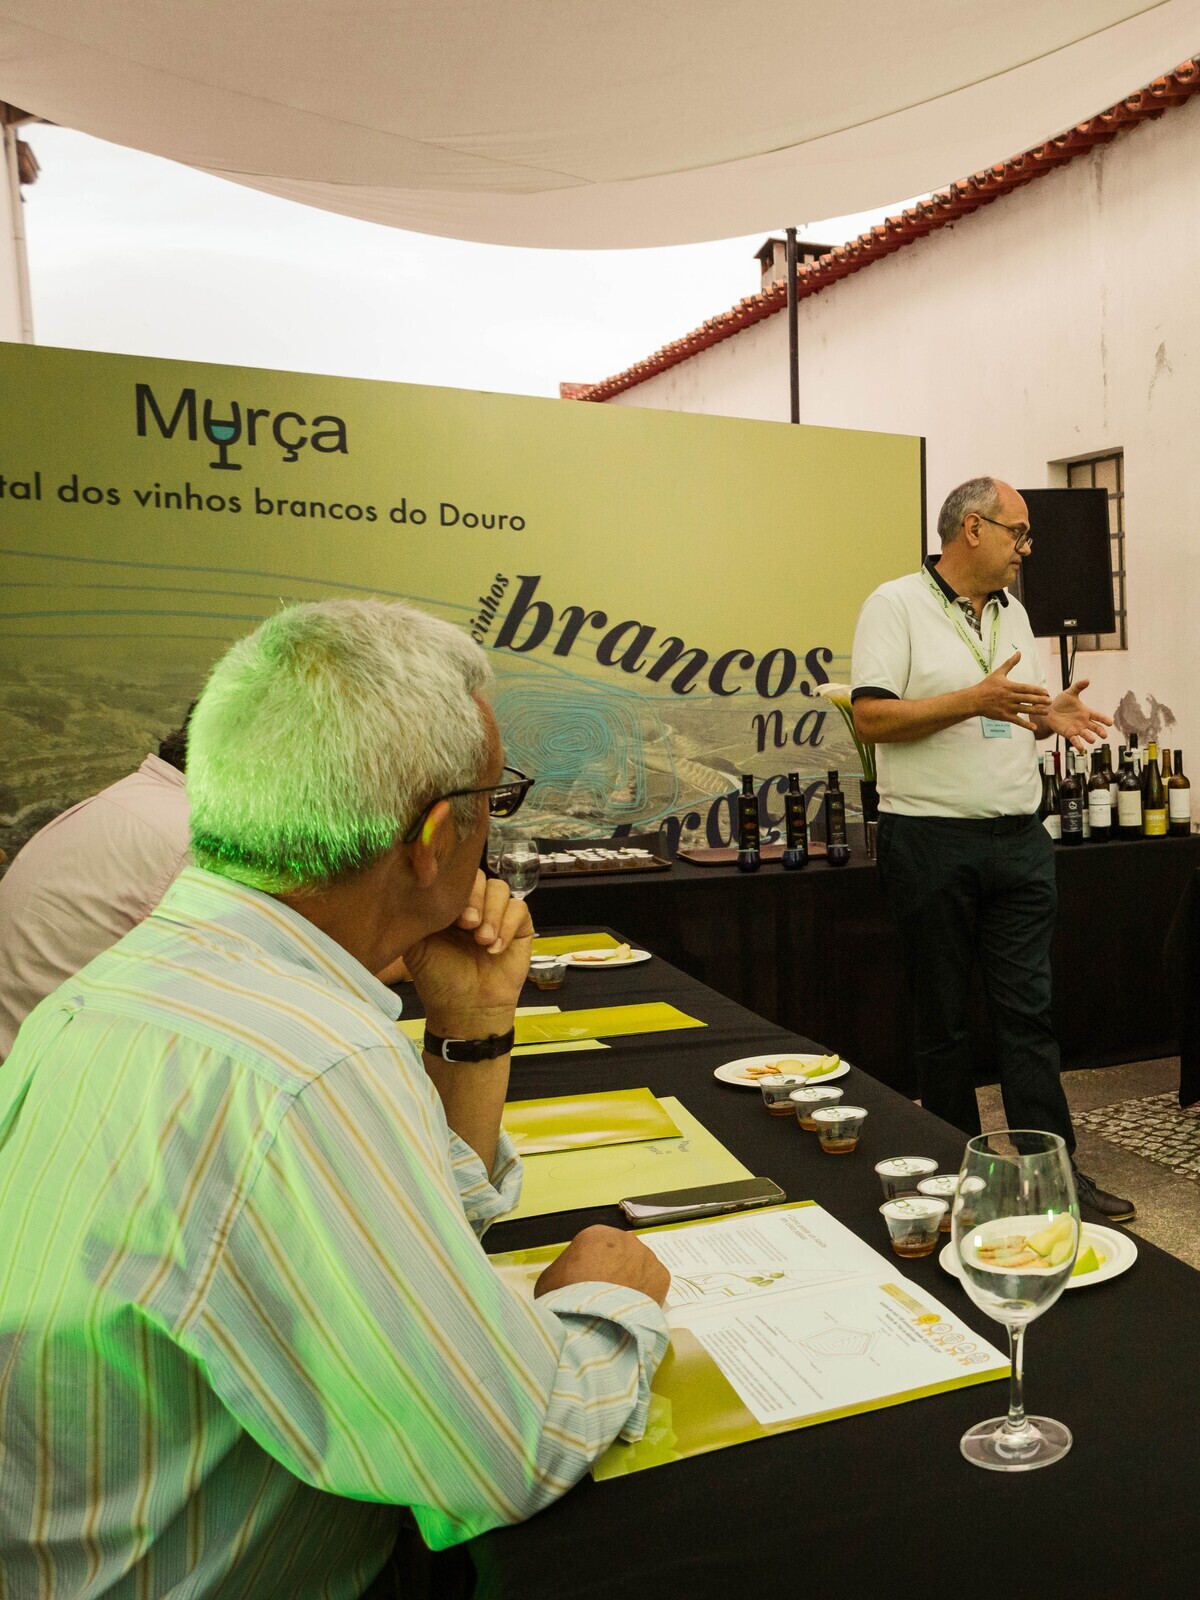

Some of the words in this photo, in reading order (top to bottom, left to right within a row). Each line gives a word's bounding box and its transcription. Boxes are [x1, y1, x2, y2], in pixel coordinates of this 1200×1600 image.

[135, 383, 349, 470] Murça
[57, 474, 121, 505] dos
[133, 482, 242, 513] vinhos
[255, 487, 378, 522] brancos
[389, 498, 427, 525] do
[440, 502, 526, 531] Douro
[493, 574, 834, 698] brancos
[751, 708, 827, 752] na
